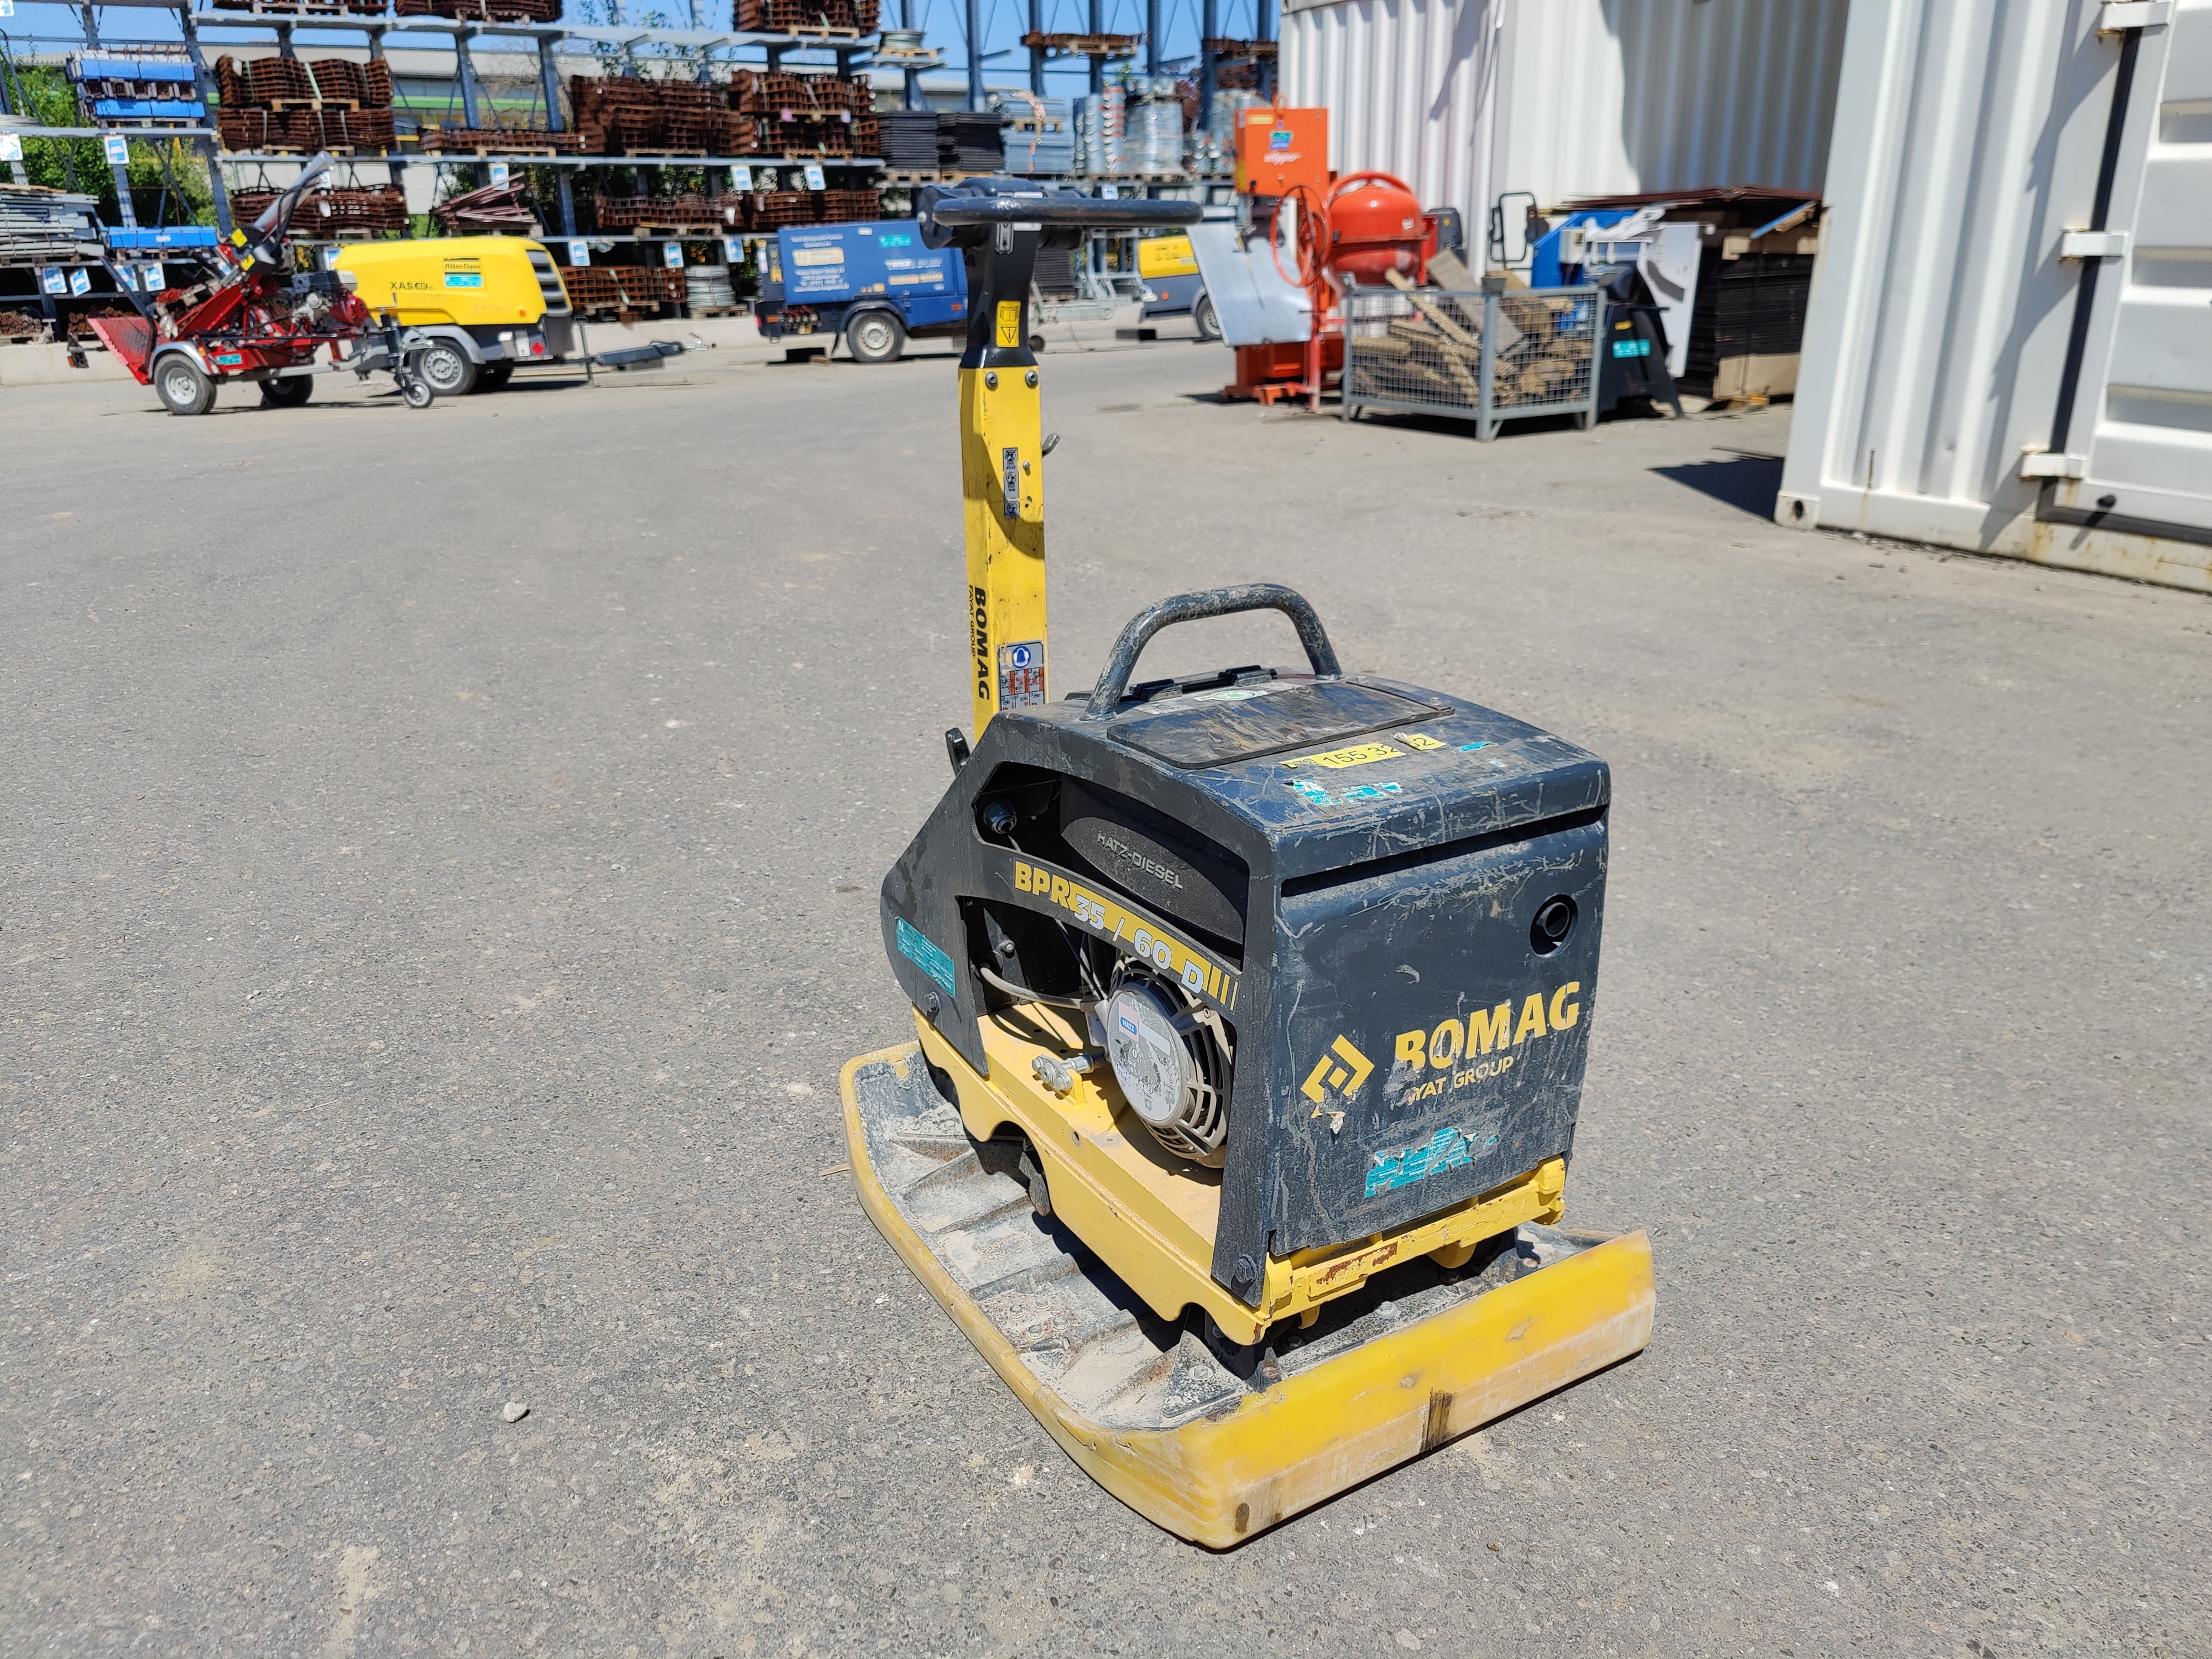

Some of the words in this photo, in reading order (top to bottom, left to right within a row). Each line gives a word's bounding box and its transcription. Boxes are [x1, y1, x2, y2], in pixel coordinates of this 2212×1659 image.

[975, 586, 990, 700] BOMAG
[1323, 750, 1368, 766] 155
[1134, 928, 1172, 970] 60
[1122, 1018, 1136, 1033] HATZ
[1395, 981, 1580, 1072] BOMAG
[1454, 1056, 1514, 1088] GROUP
